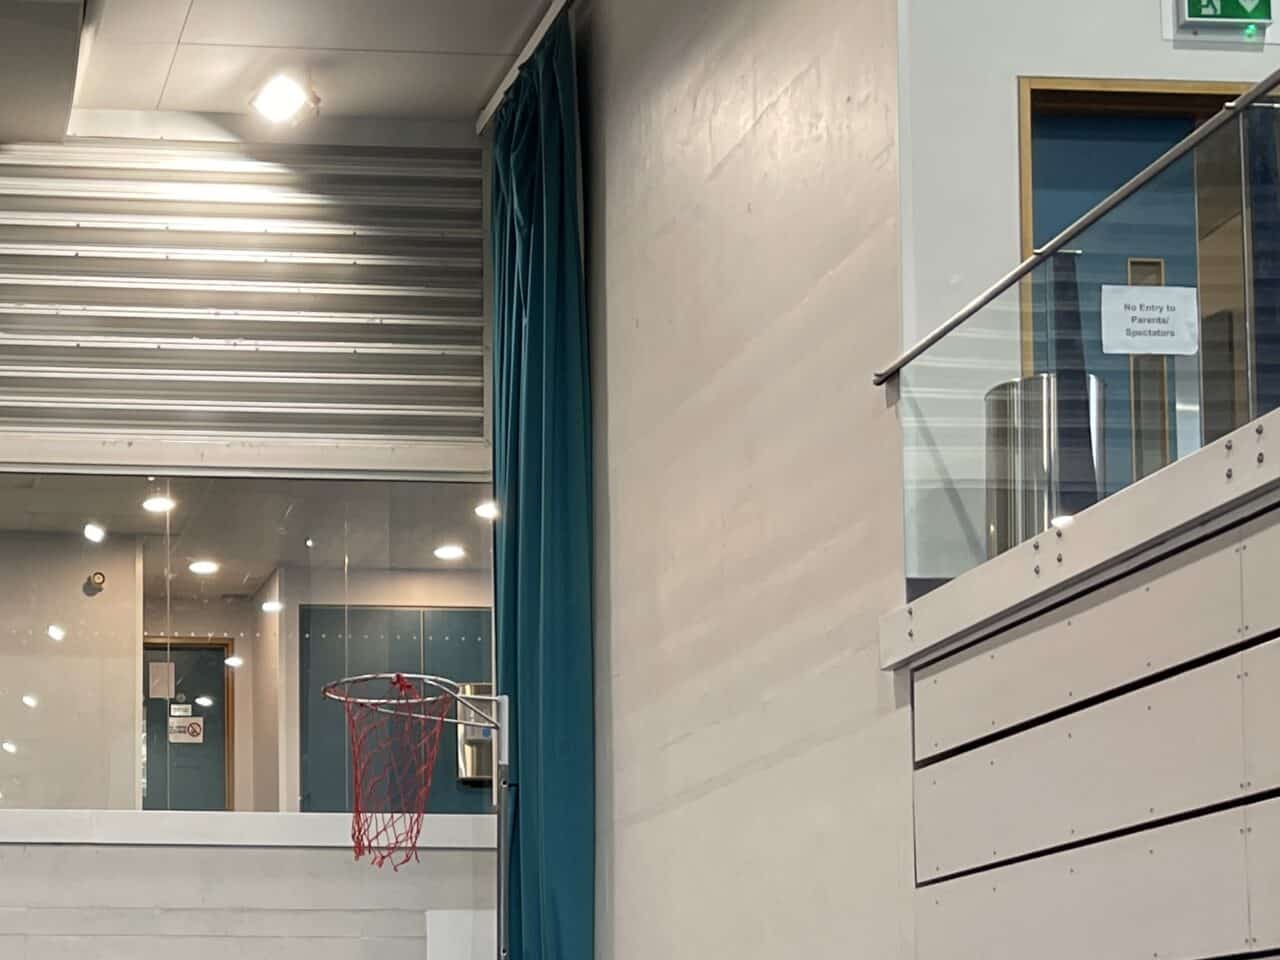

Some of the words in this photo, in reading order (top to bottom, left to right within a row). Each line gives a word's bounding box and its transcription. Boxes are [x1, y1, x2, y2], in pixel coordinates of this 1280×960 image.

[1124, 304, 1137, 312] No
[1139, 304, 1163, 313] Entry
[1166, 304, 1176, 312] to
[1126, 328, 1175, 338] Spectators
